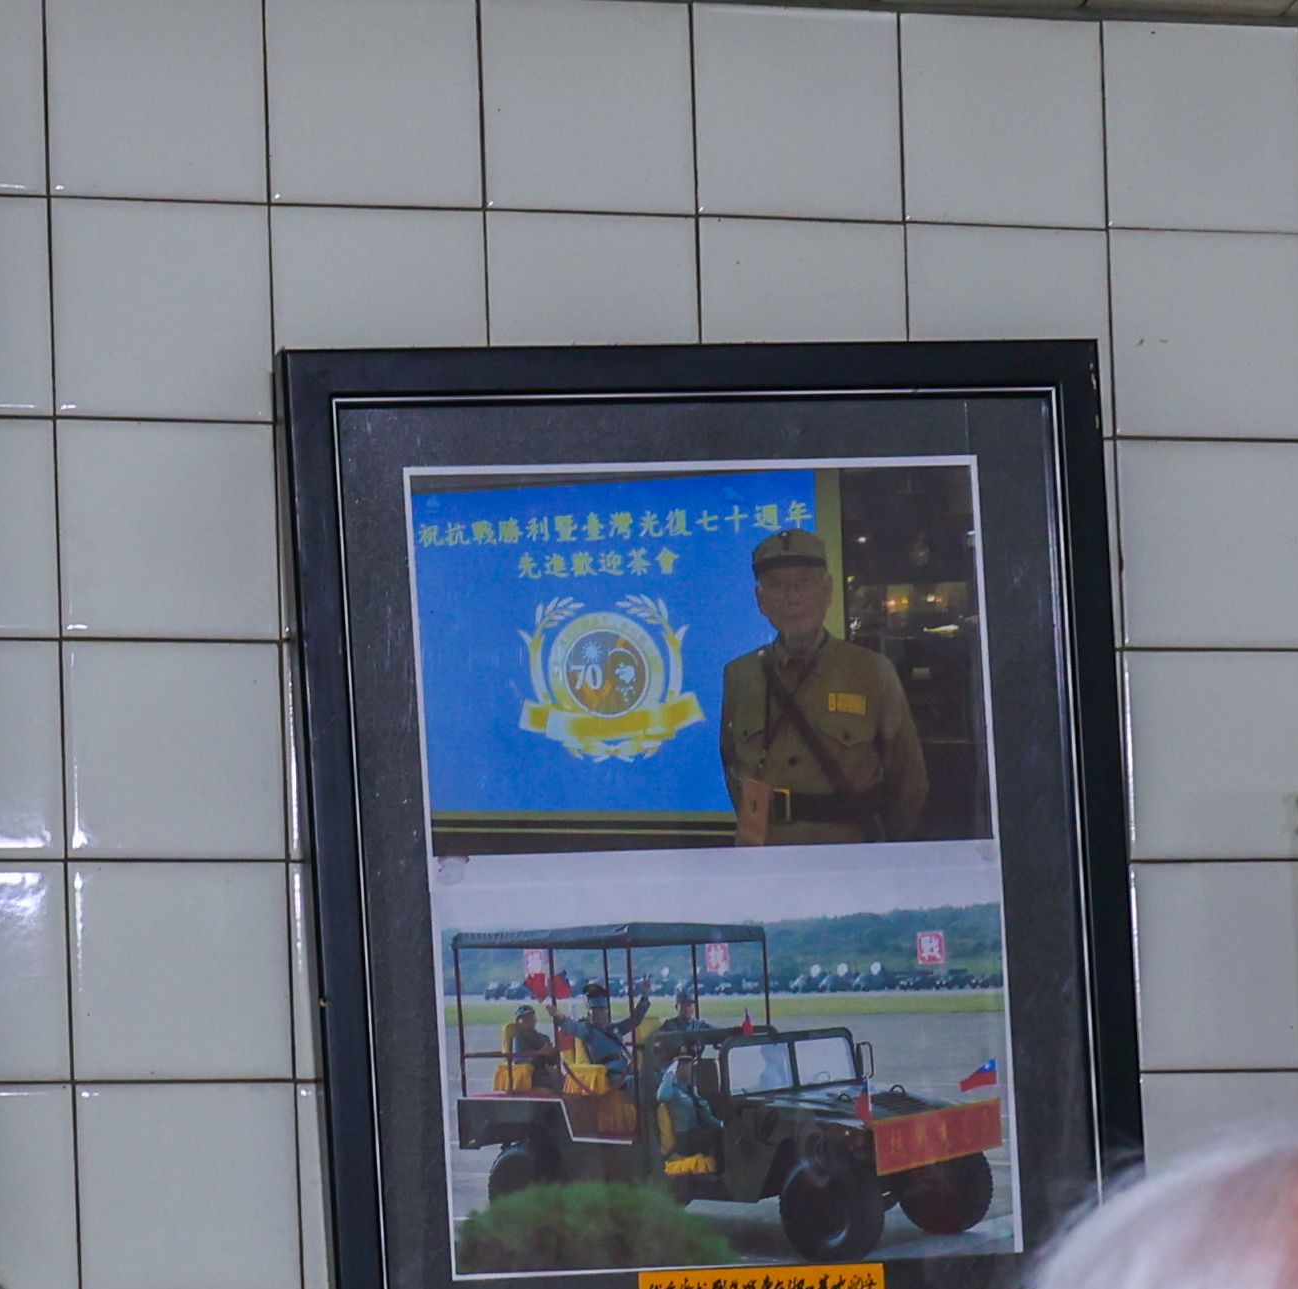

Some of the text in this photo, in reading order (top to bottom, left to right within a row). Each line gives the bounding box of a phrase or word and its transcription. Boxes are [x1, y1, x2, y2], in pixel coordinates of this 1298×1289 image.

[419, 500, 813, 548] 祝抗戰勝利暨臺灣光復七十週年
[518, 547, 680, 579] 先進歡迎茶會
[569, 663, 605, 691] 70
